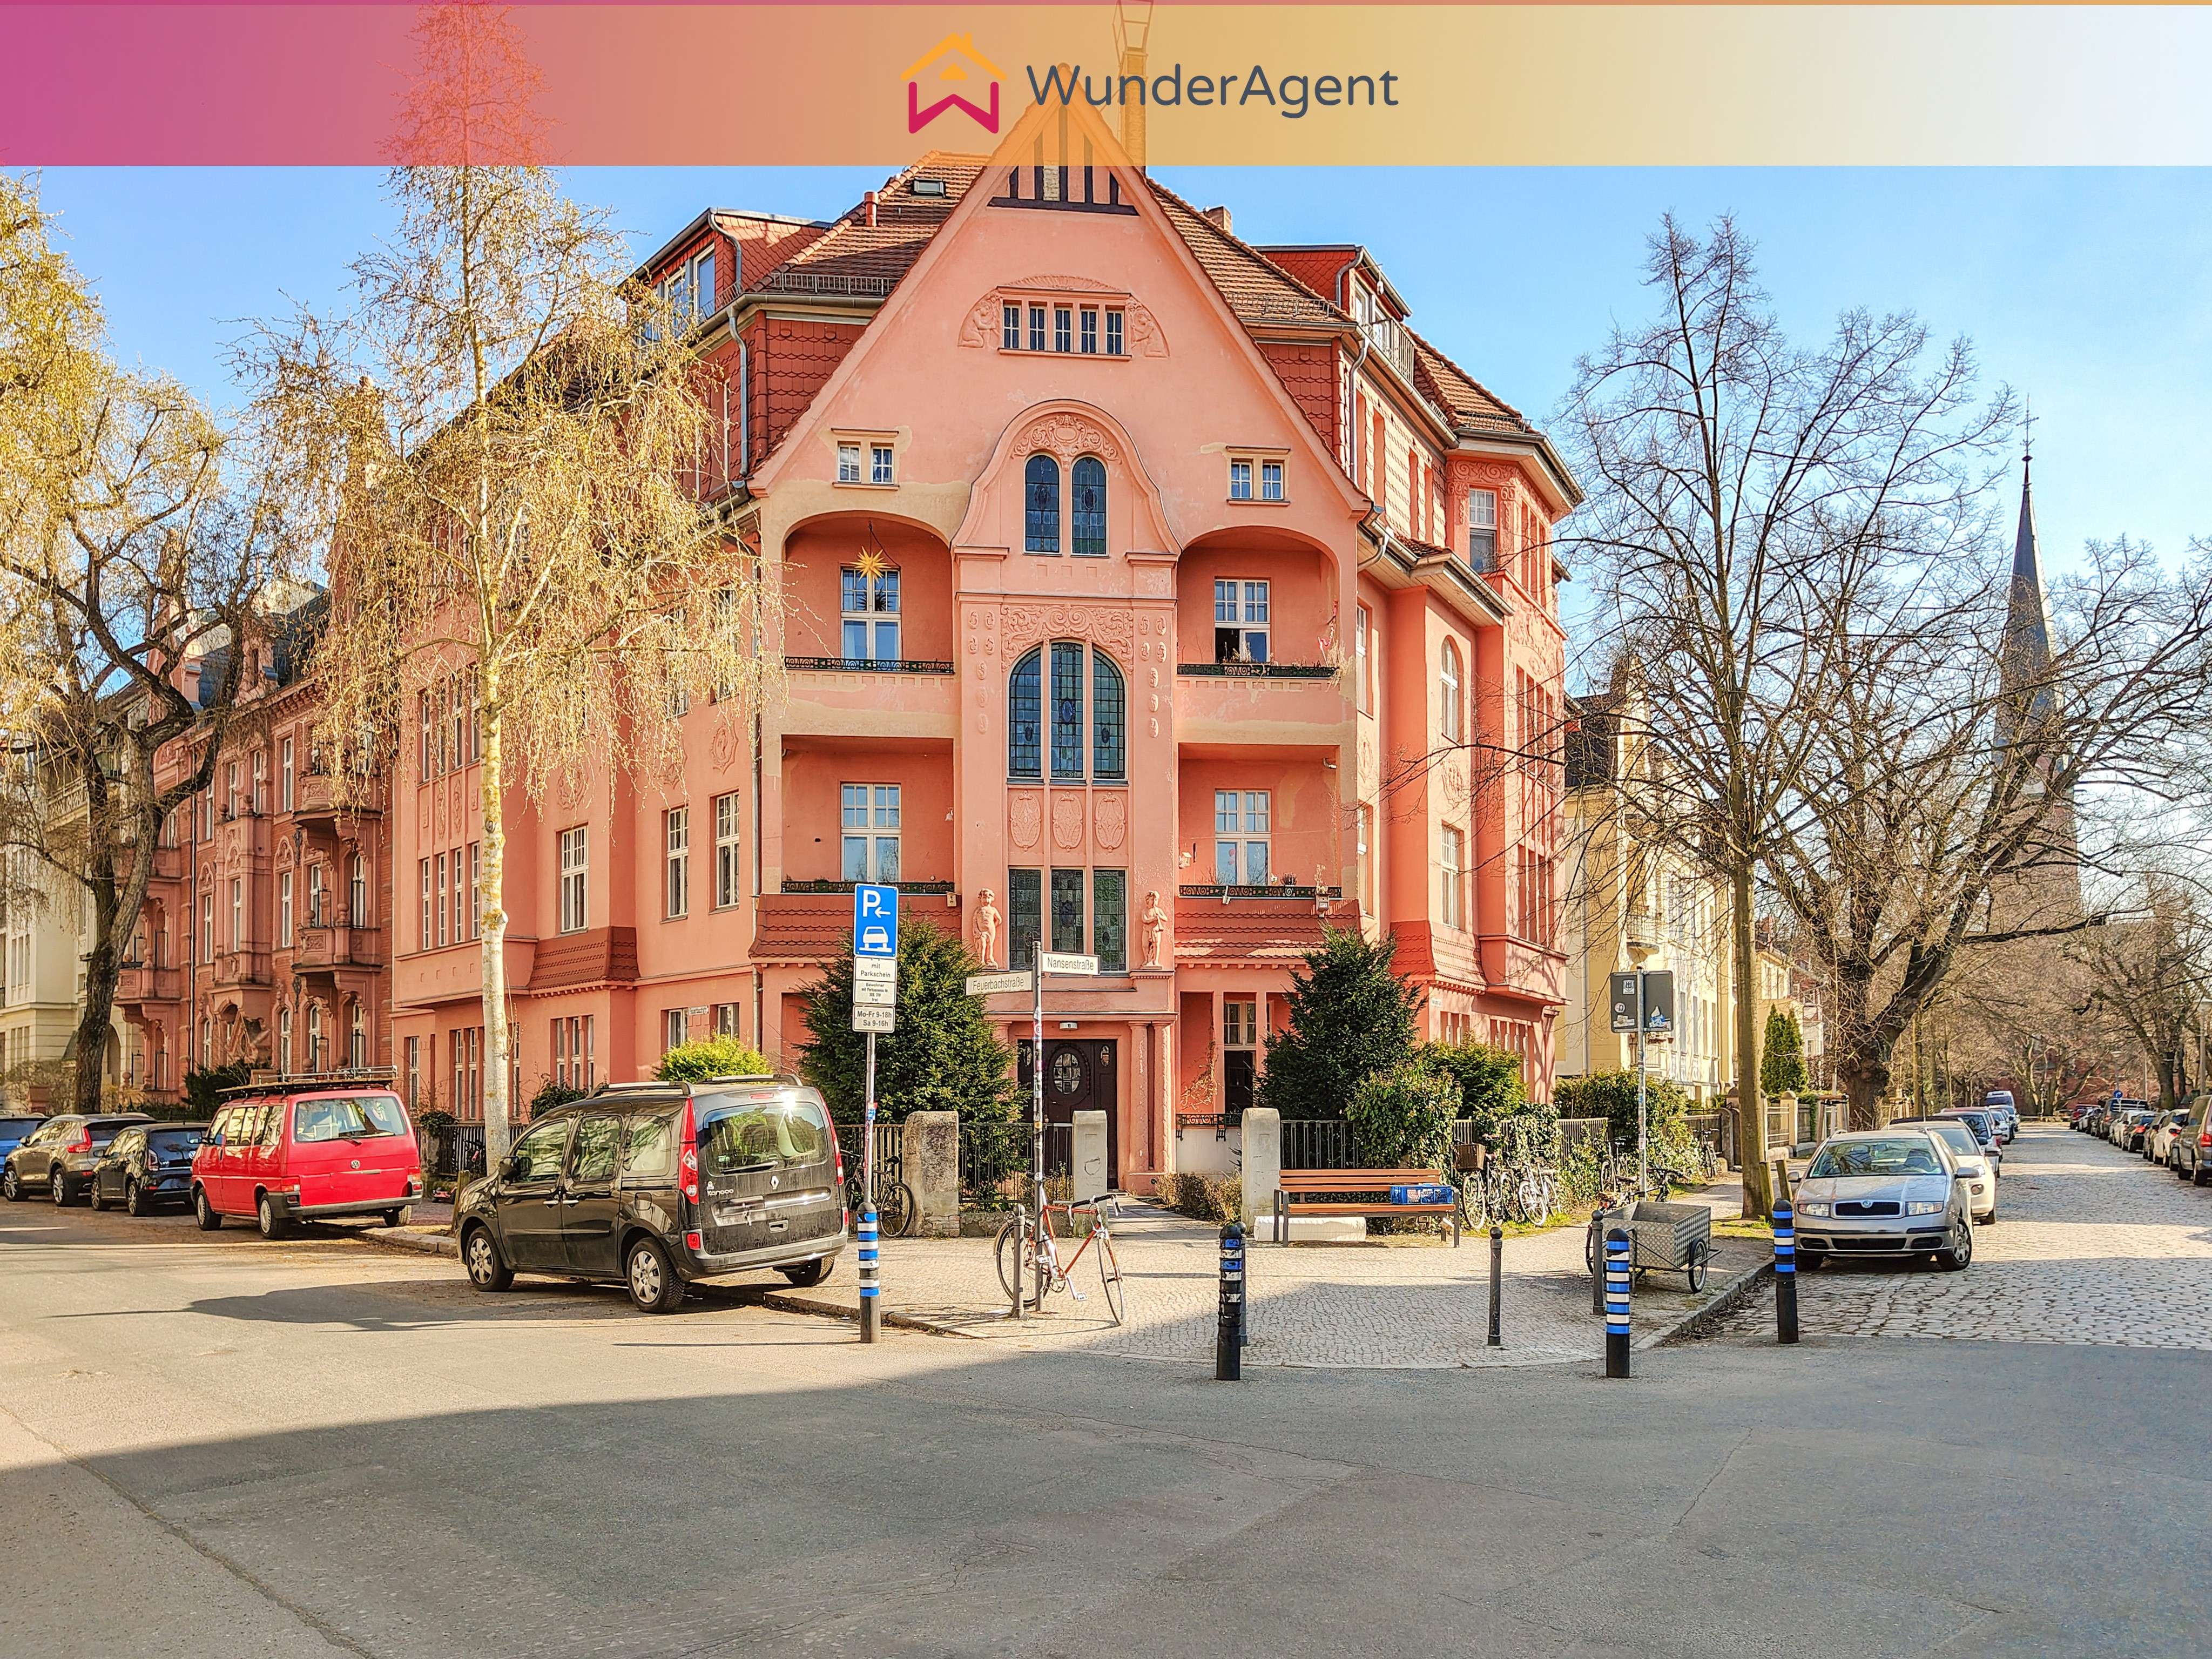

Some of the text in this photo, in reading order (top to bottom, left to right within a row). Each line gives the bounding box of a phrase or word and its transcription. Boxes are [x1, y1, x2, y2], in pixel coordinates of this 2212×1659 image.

[862, 889, 881, 917] P
[1047, 956, 1094, 970] Nansenstraße
[973, 976, 1024, 990] Feuerbachstraße
